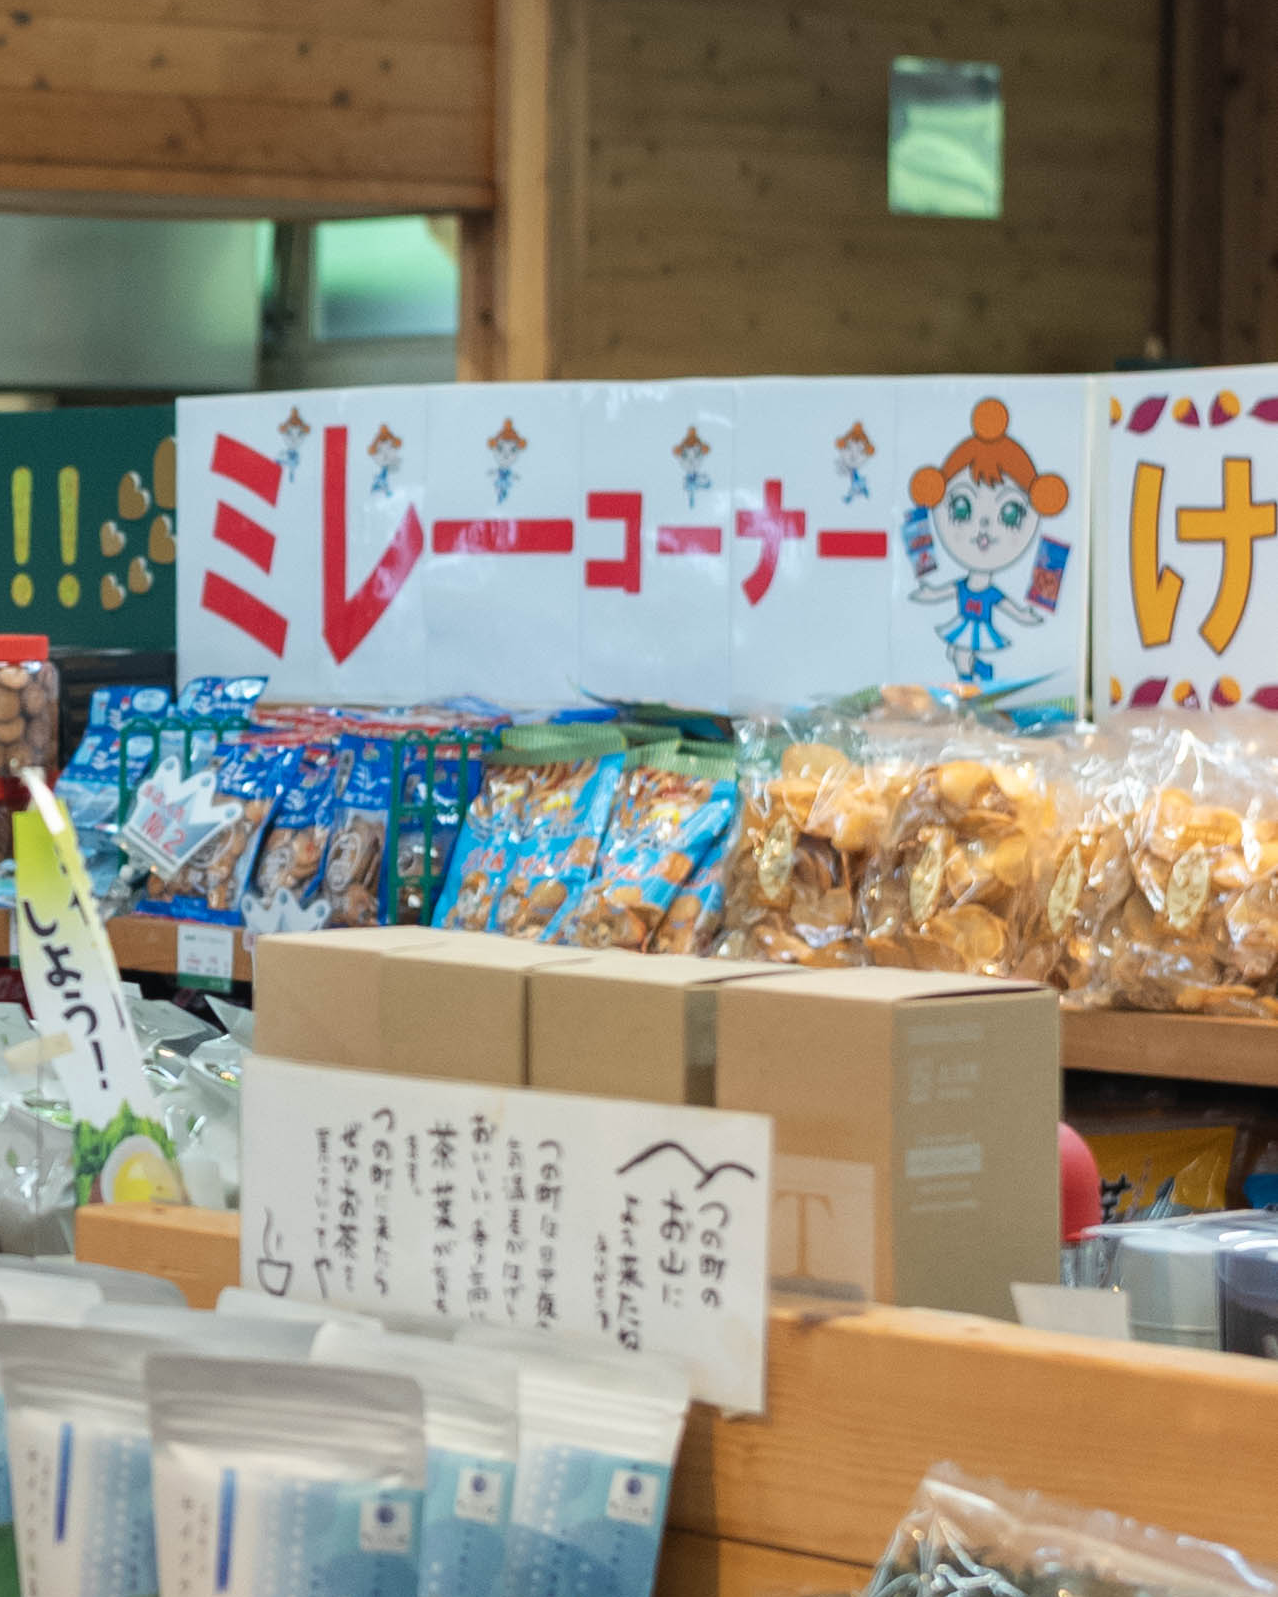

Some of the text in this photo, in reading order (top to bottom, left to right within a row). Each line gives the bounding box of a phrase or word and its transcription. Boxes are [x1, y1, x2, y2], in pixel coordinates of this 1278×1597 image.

[201, 425, 888, 665] ミレーコーナー
[699, 1201, 730, 1308] つの町の
